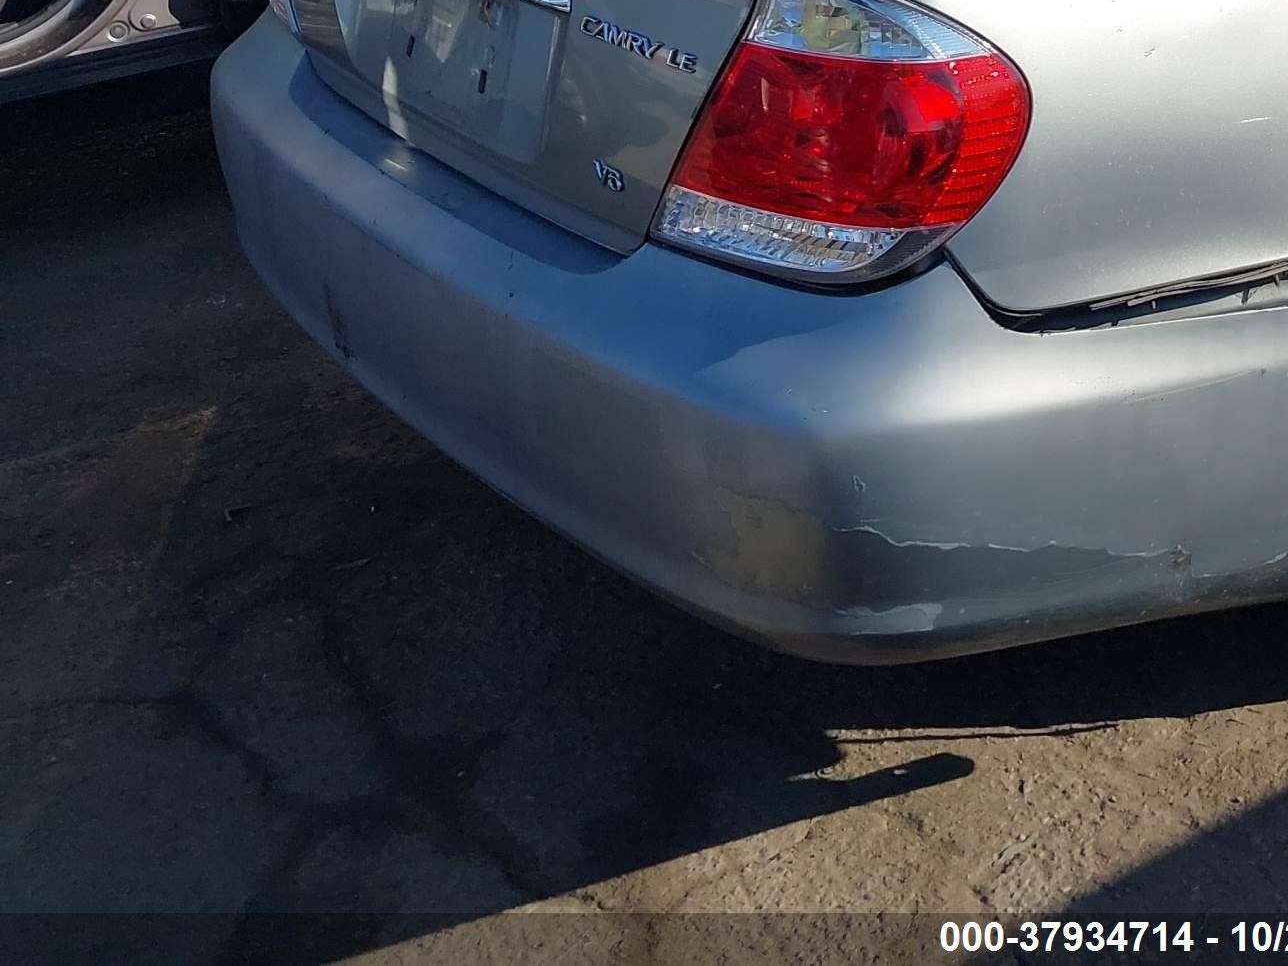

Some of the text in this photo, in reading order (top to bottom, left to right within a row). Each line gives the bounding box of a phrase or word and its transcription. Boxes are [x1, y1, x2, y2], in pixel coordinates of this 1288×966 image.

[579, 15, 699, 74] CAMRY LE
[592, 158, 625, 192] V6
